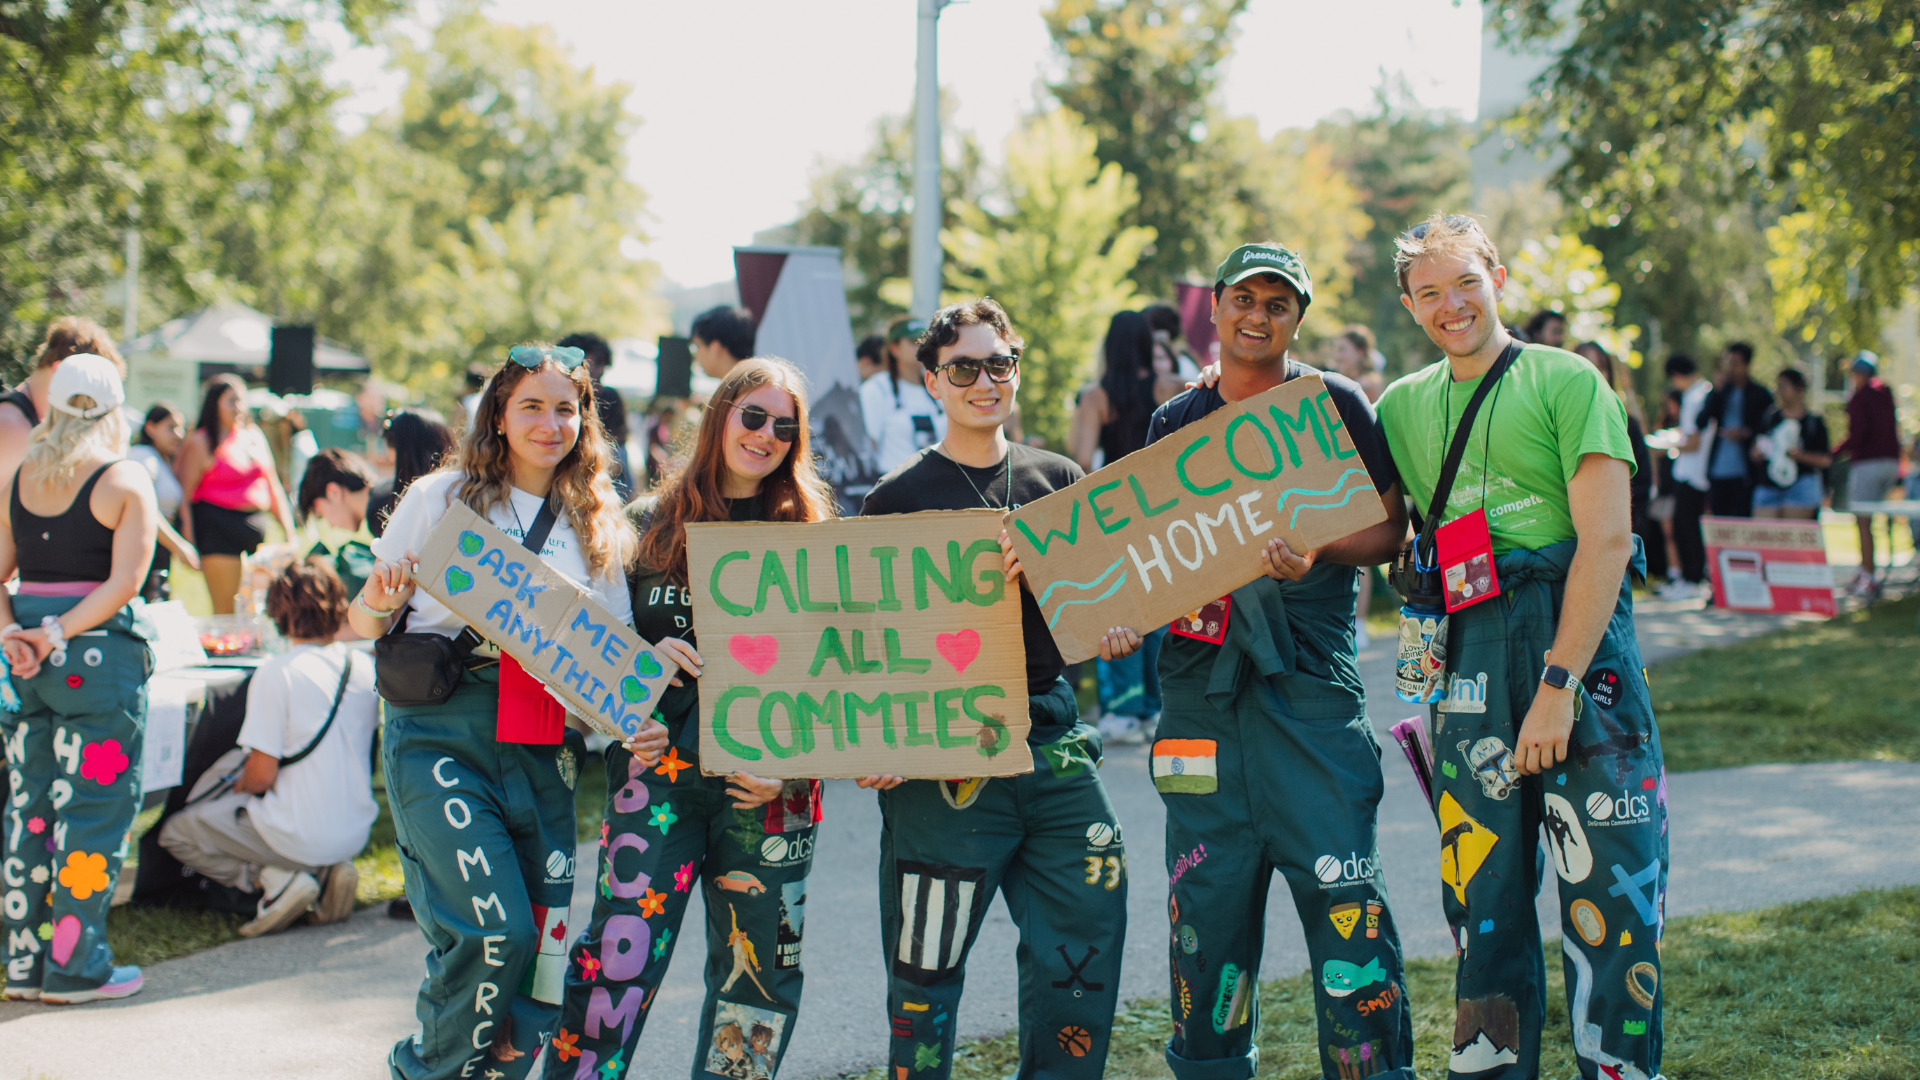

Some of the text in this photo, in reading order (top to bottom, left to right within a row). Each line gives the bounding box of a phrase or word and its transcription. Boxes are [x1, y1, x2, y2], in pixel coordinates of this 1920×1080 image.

[1014, 390, 1358, 556] WELCOME
[709, 538, 1006, 616] CALLING
[1127, 489, 1273, 593] HOME
[478, 548, 629, 667] ASK ME
[485, 599, 642, 735] ANYTHING
[807, 626, 931, 677] ALL
[1597, 682, 1613, 694] ENG
[711, 684, 1011, 761] COMMIES
[1592, 693, 1612, 706] GIRLS
[1615, 789, 1649, 819] dcs
[788, 833, 813, 860] dcs
[1343, 851, 1374, 880] dcs
[432, 757, 507, 1077] COMMERCE
